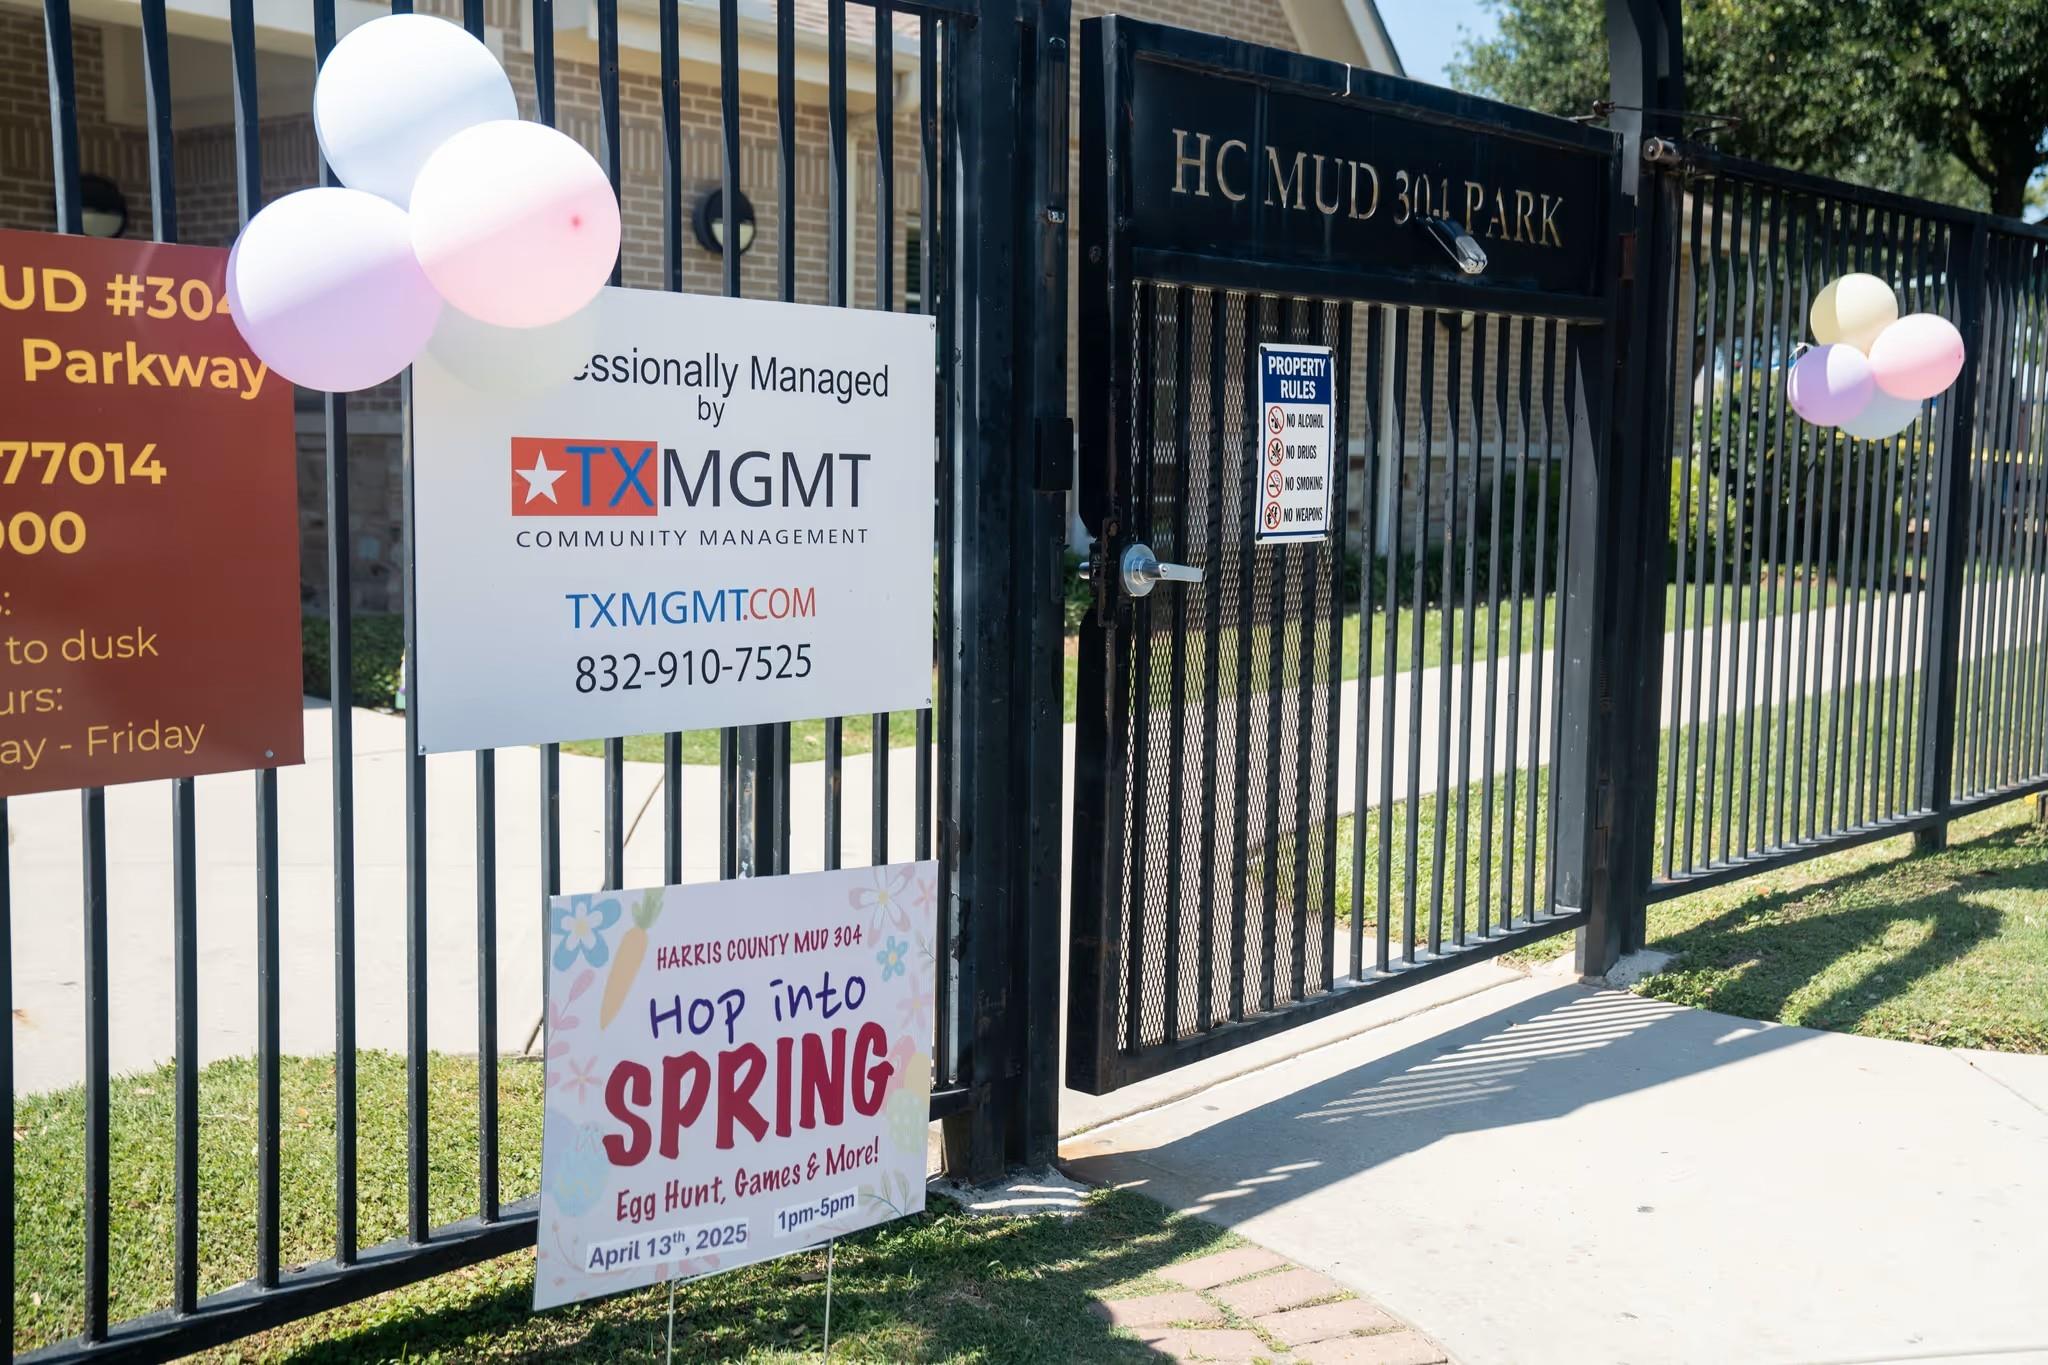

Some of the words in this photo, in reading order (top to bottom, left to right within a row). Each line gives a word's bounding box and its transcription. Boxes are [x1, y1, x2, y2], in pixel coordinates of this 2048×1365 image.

[1171, 128, 1247, 202] HC
[1264, 145, 1379, 221] MUD
[1464, 180, 1563, 248] PARK
[22, 338, 268, 400] Parkway
[751, 355, 889, 404] Managed
[1268, 355, 1326, 377] PROPERTY
[698, 394, 726, 428] by
[1280, 379, 1316, 400] RULES
[1286, 413, 1296, 428] NO
[1297, 414, 1325, 429] ALCOHOL
[0, 441, 167, 486] 77014
[1285, 445, 1295, 460] NO
[1297, 445, 1317, 460] DRUGS
[565, 446, 871, 508] TXMGMT
[1284, 477, 1295, 492] NO
[1296, 476, 1324, 492] SMOKING
[0, 510, 87, 556] 00
[1283, 507, 1294, 523] NO
[1295, 507, 1324, 523] WEAPONS
[516, 530, 687, 548] COMMUNITY
[700, 528, 869, 545] MANAGEMENT
[565, 587, 817, 629] TXMGMT.COM
[5, 636, 48, 664] to
[61, 626, 159, 661] dusk
[575, 643, 813, 694] 832-910-7525
[87, 720, 206, 757] Friday
[657, 942, 722, 970] HARRIS
[727, 933, 788, 962] COUNTY
[794, 930, 828, 953] MUD
[834, 924, 862, 948] 304
[769, 971, 866, 1022] into
[602, 1021, 895, 1167] SPRING
[616, 1189, 656, 1224] Egg
[664, 1179, 726, 1212] Hunt,
[734, 1166, 800, 1198] Games
[806, 1152, 820, 1180] &
[826, 1136, 879, 1177] More!
[777, 1192, 855, 1232] 1pm-5pm
[589, 1243, 640, 1271] April
[696, 1222, 748, 1249] 2025
